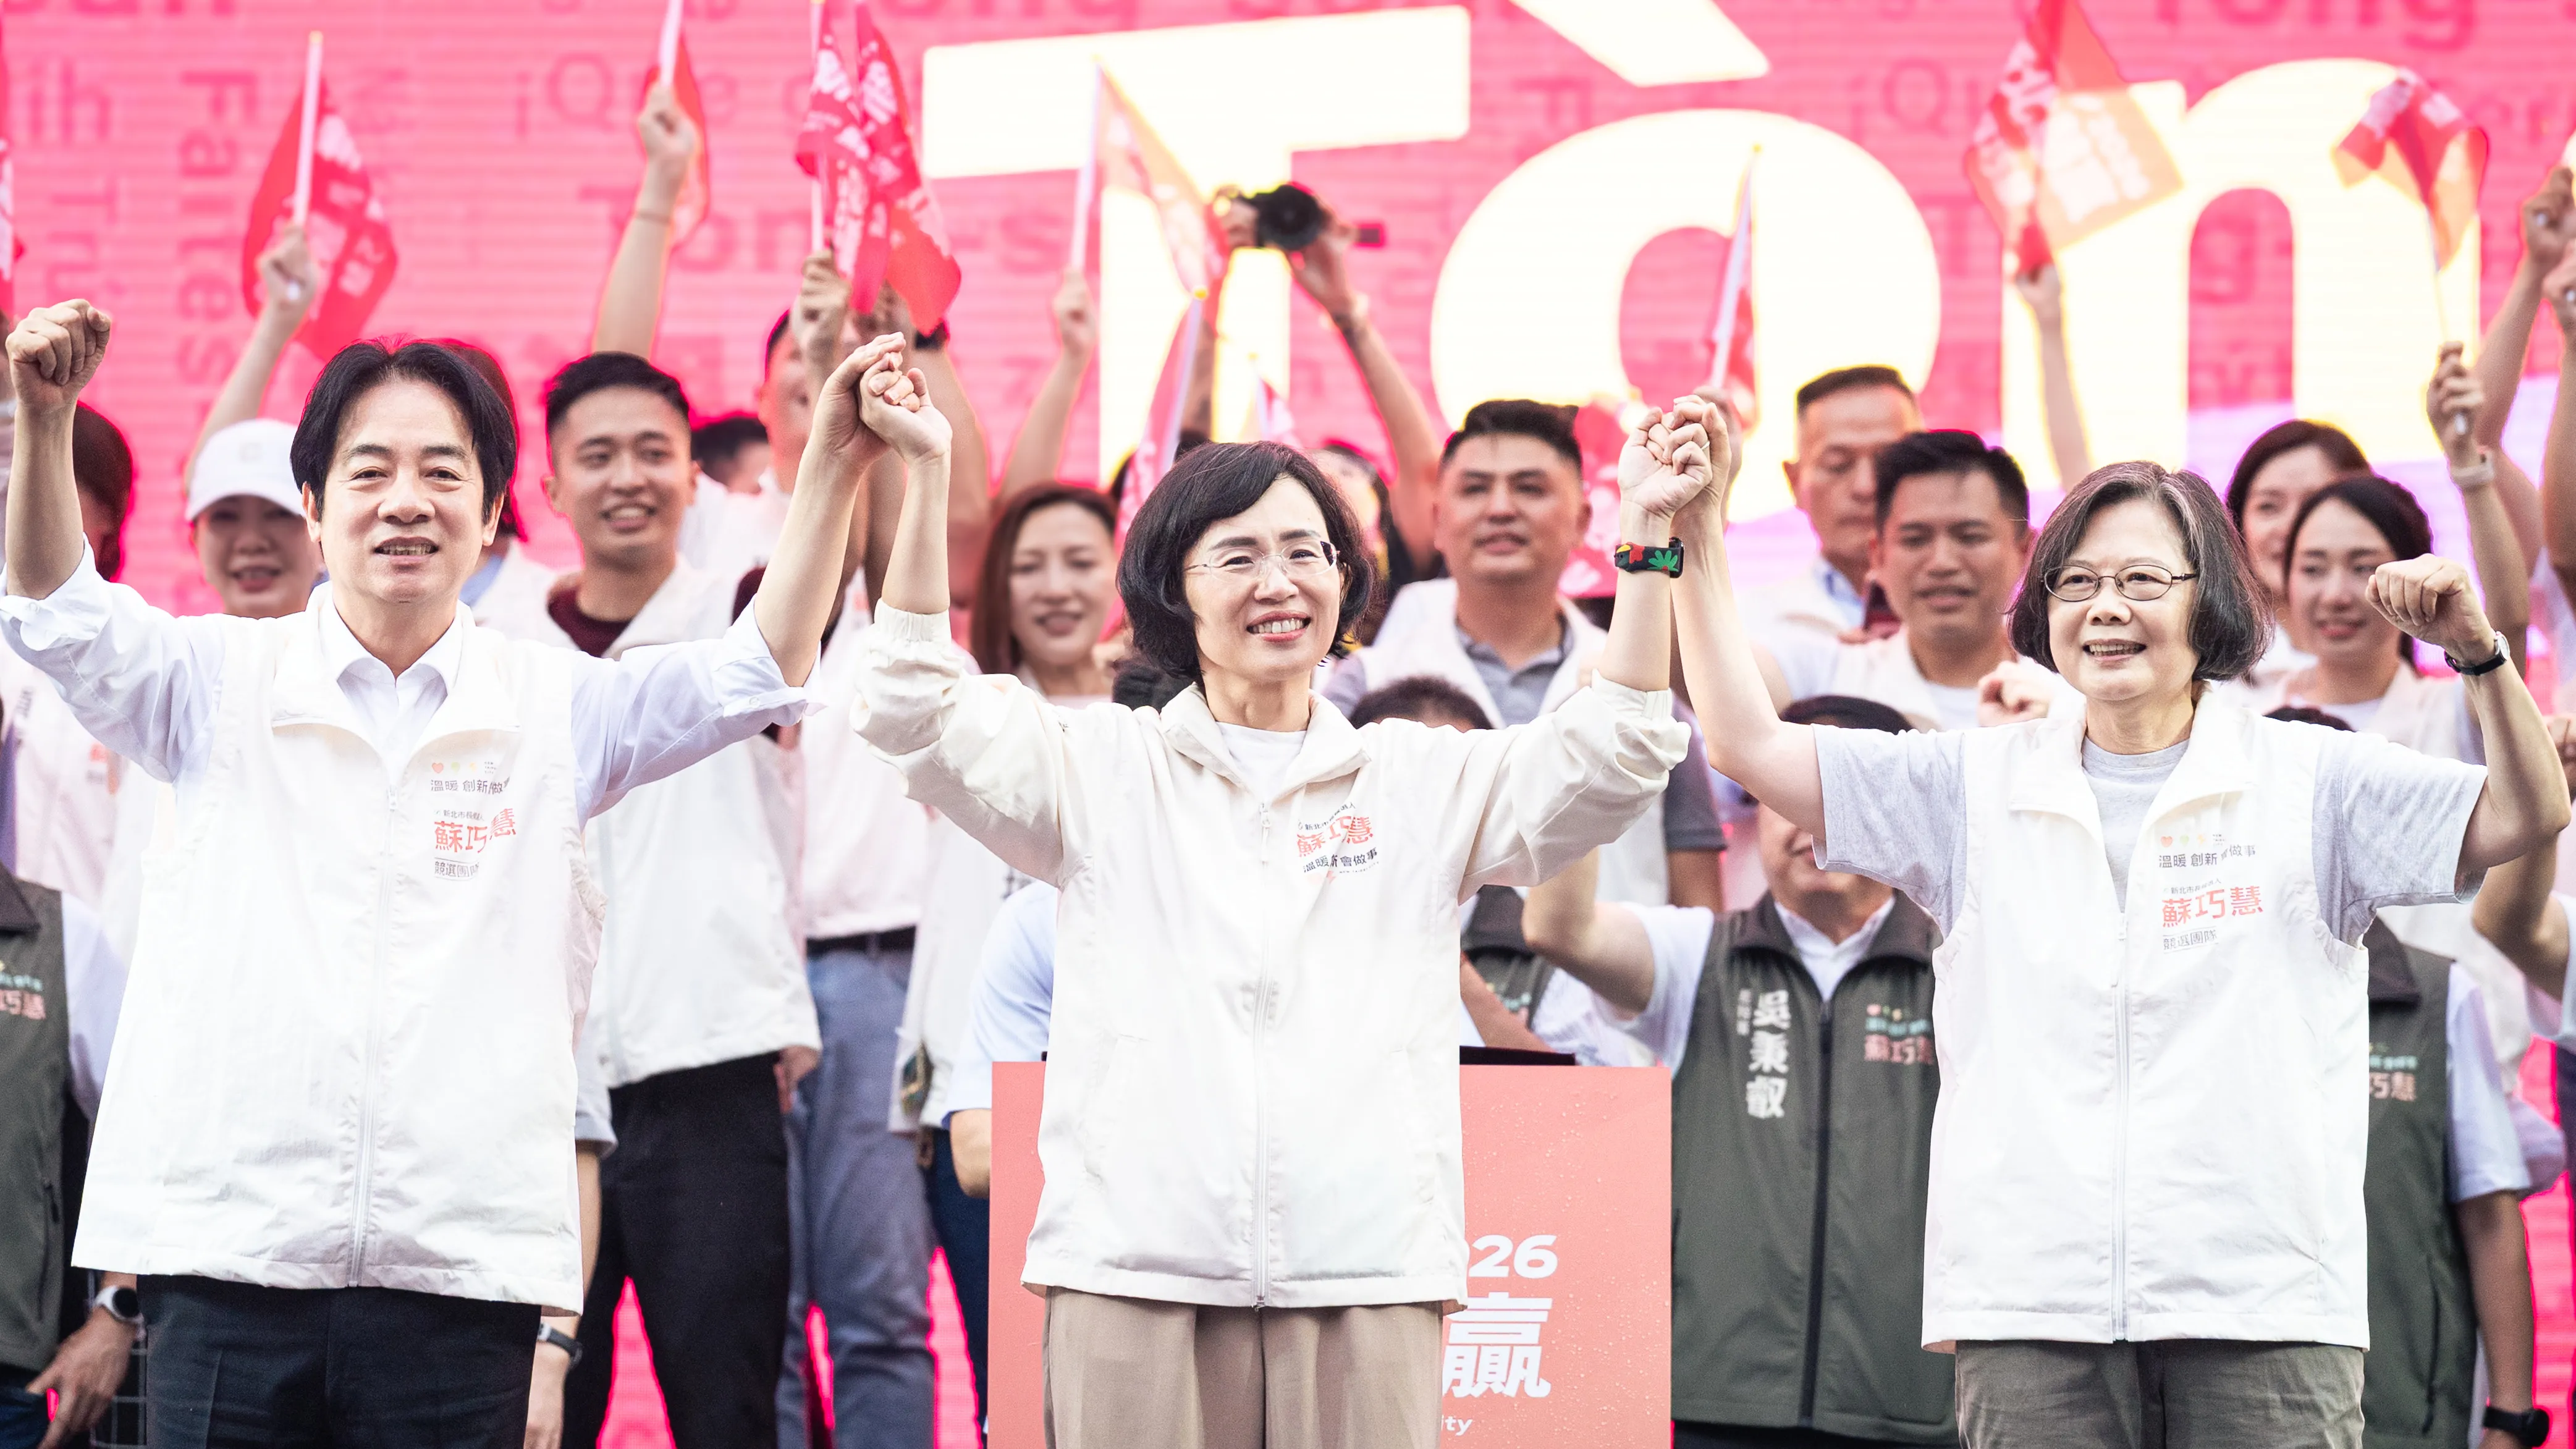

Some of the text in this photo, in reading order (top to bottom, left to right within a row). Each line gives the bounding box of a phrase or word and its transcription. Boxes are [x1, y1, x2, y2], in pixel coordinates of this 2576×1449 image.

[431, 779, 458, 792] 溫暖
[463, 779, 488, 793] 創新
[434, 808, 516, 853] 蘇巧慧
[1297, 816, 1373, 858] 蘇巧慧
[2159, 854, 2187, 868] 溫暖
[2191, 852, 2218, 866] 創新
[2162, 885, 2263, 927] 蘇巧慧
[2163, 929, 2218, 950] 競選團隊
[1467, 1235, 1558, 1279] 26
[1442, 1414, 1473, 1437] ity
